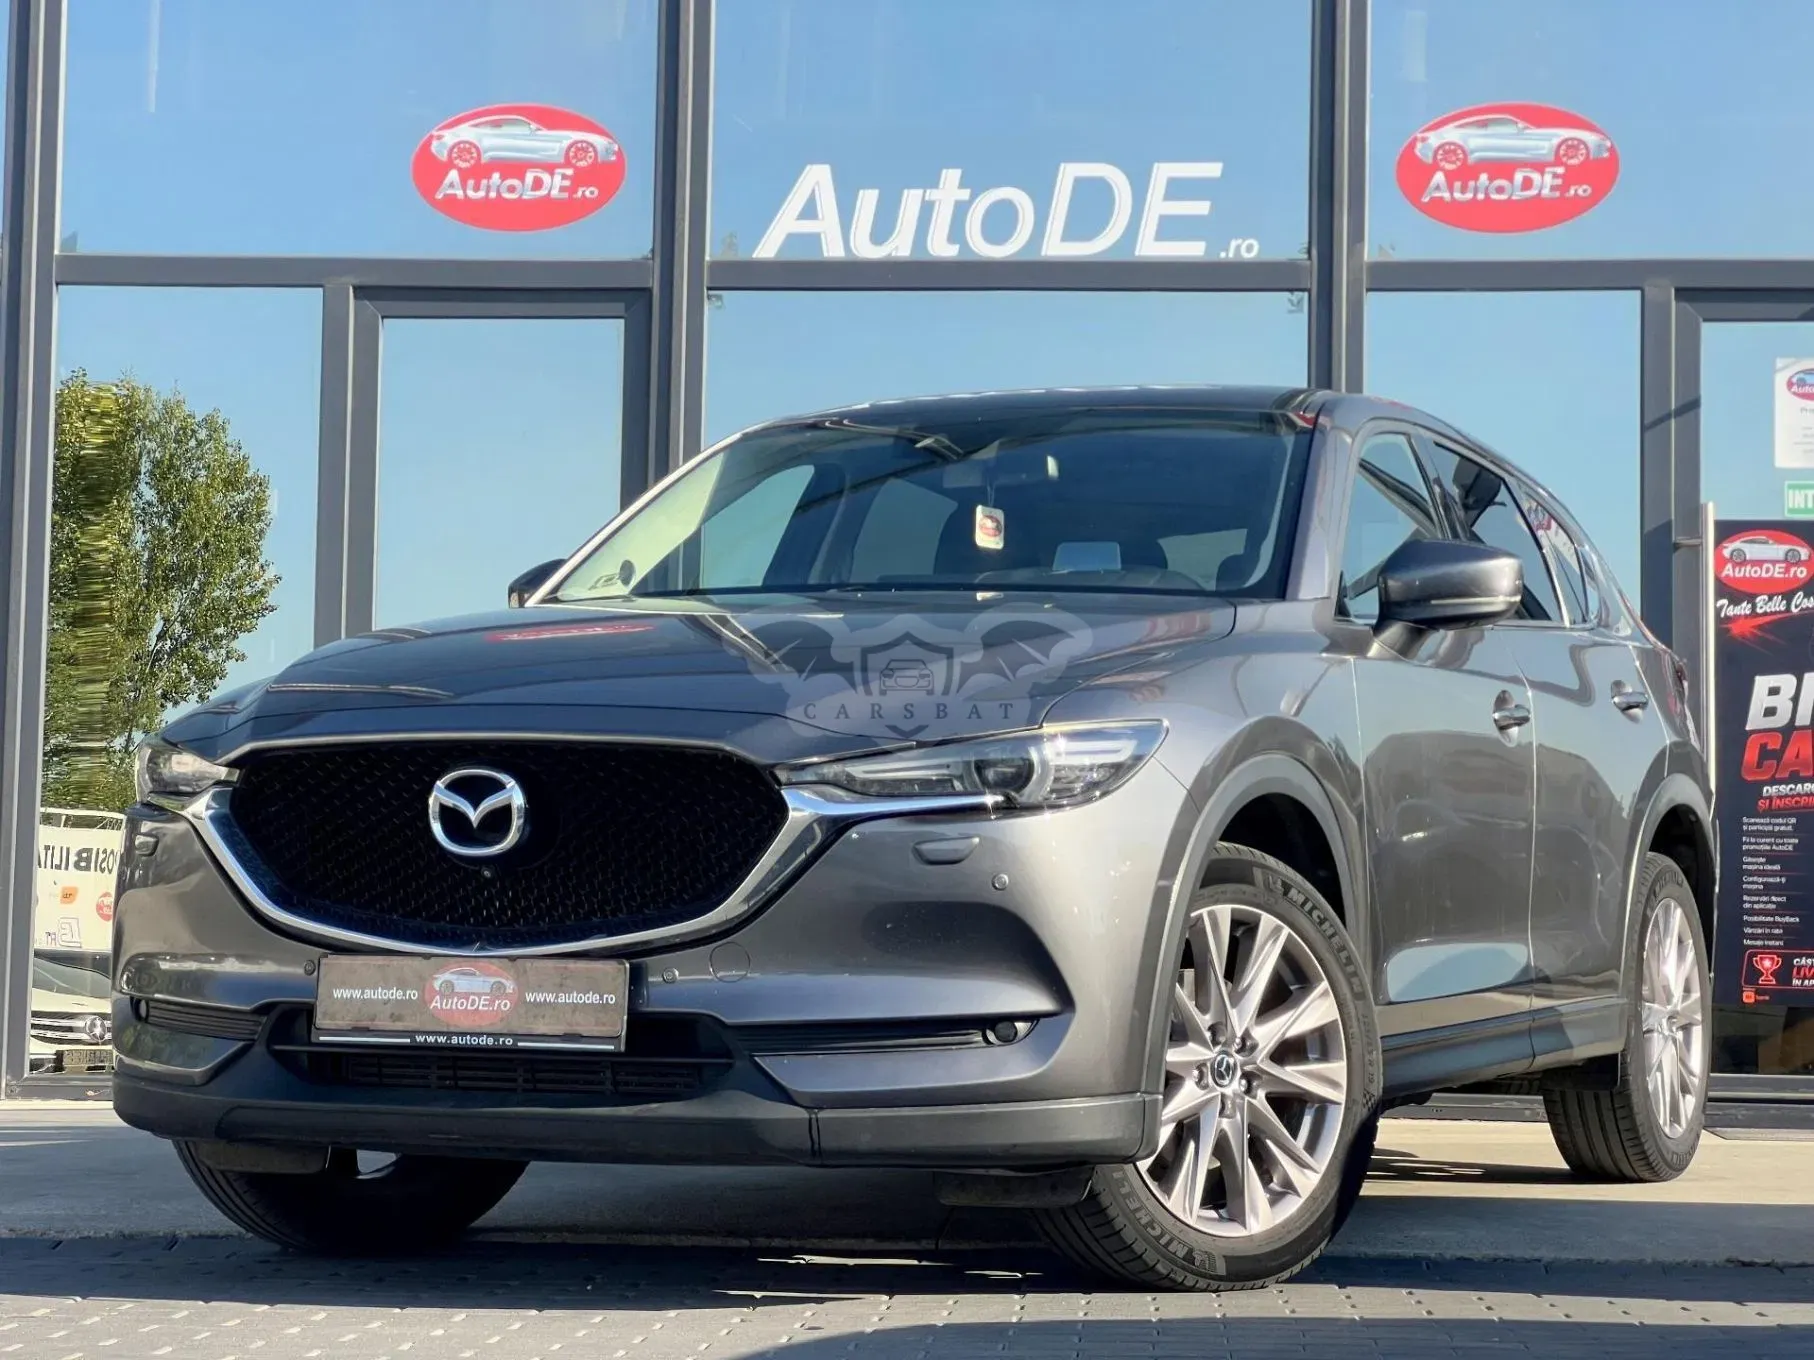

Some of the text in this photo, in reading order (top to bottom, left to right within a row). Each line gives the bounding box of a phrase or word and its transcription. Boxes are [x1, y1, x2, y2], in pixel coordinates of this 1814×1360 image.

[1721, 563, 1808, 578] AutoDE.ro
[1286, 890, 1364, 993] MICHELIN
[333, 986, 419, 1000] www.autode.ro
[525, 991, 616, 1005] www.autode.ro
[430, 995, 511, 1011] AutoDE.ro
[415, 1034, 513, 1047] www.autode.ro
